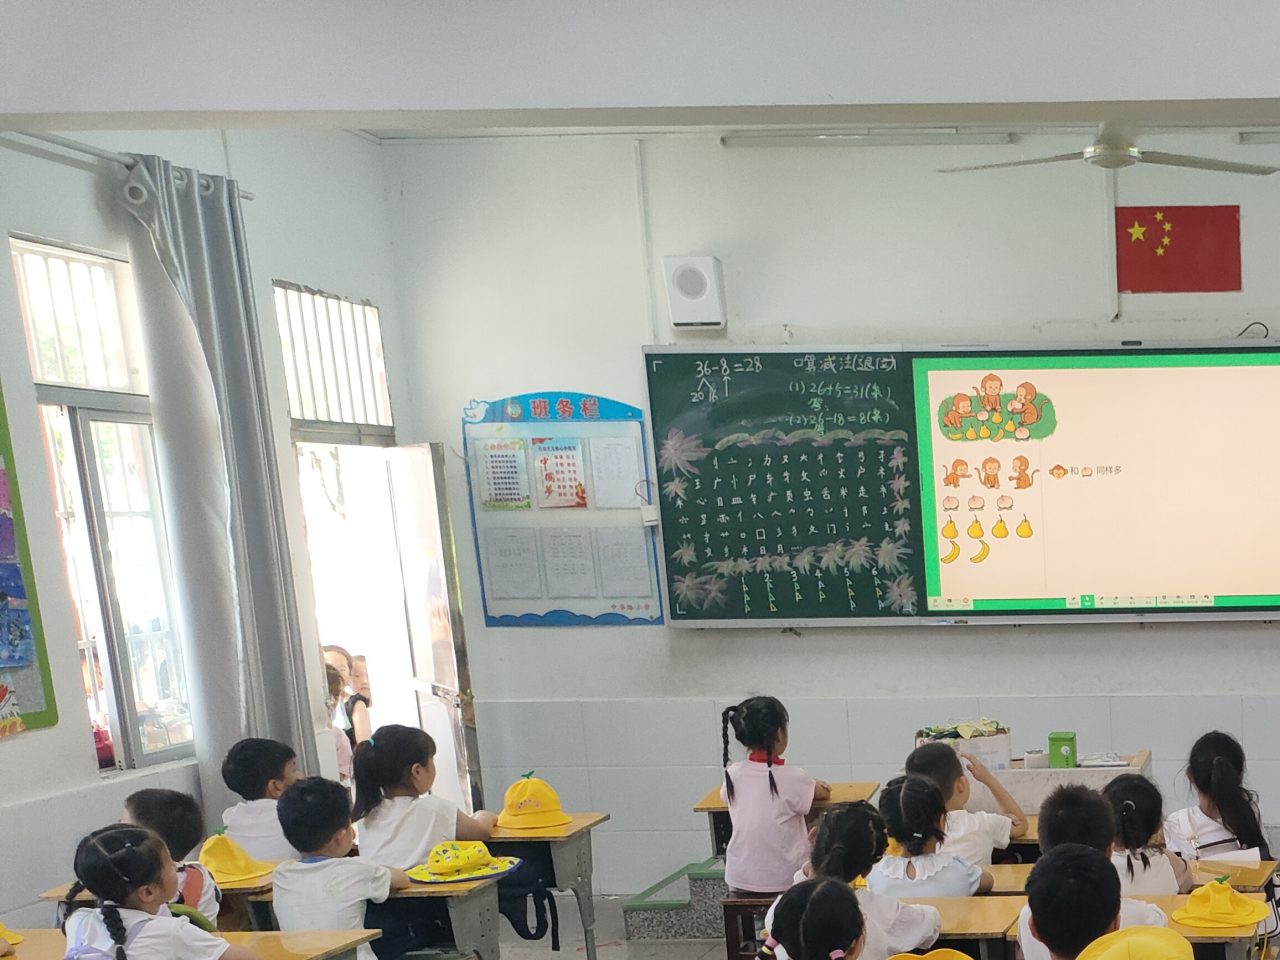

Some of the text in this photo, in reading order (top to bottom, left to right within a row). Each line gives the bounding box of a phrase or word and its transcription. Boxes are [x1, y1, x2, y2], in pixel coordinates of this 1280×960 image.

[696, 356, 763, 378] 36-8=28
[529, 398, 601, 419] 班务栏
